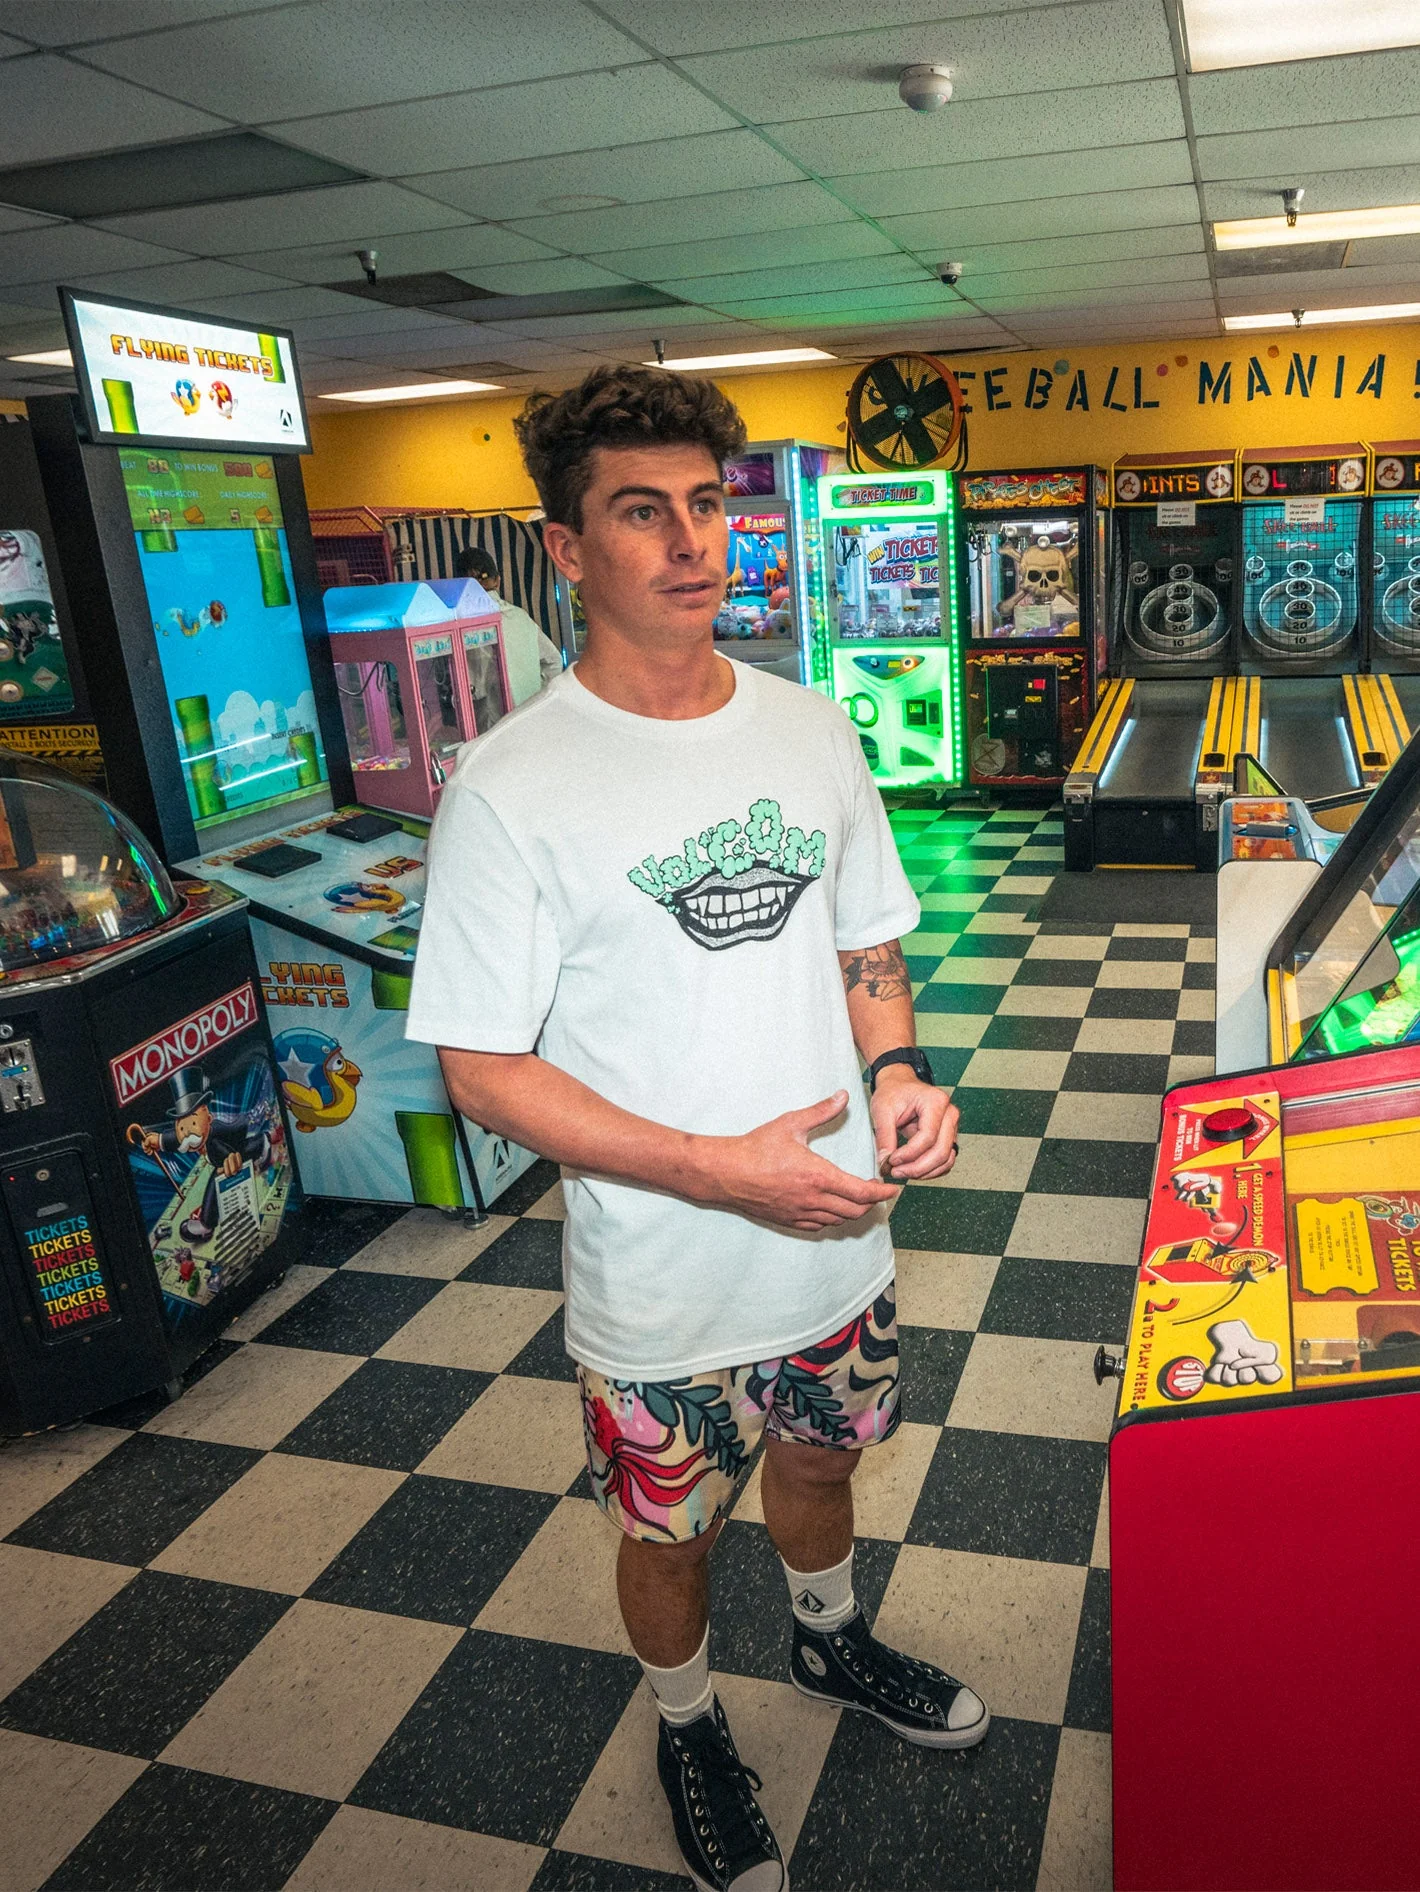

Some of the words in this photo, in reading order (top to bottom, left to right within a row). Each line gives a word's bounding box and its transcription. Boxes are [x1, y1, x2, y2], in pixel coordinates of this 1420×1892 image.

[110, 333, 190, 365] FLYING
[193, 346, 274, 377] TICKETS
[868, 365, 1160, 413] EEBALL
[1198, 352, 1386, 404] MANIA
[851, 487, 887, 504] TICKET
[889, 486, 918, 502] TIME
[1143, 474, 1199, 494] INTS
[867, 544, 885, 565] WIN
[883, 536, 938, 563] TICKET
[869, 563, 915, 583] TICKETS
[1172, 605, 1187, 613] 30
[1292, 602, 1307, 610] 30
[1172, 624, 1186, 632] 20
[1292, 621, 1308, 630] 20
[1172, 639, 1185, 647] 10
[1294, 636, 1306, 644] 10
[0, 727, 95, 741] ATTENTION
[119, 990, 250, 1097] MONOPOLY
[1237, 1180, 1248, 1199] HERE
[1252, 1173, 1263, 1187] GET
[1252, 1194, 1263, 1215] SPEED
[24, 1215, 88, 1244] TICKETS
[1252, 1215, 1264, 1247] DEMON
[28, 1229, 92, 1258] TICKETS
[32, 1243, 96, 1272] TICKETS
[1387, 1238, 1417, 1291] TICKETS
[36, 1257, 99, 1286] TICKETS
[40, 1271, 103, 1300] TICKETS
[44, 1285, 107, 1314] TICKETS
[48, 1299, 110, 1328] TICKETS
[1142, 1325, 1155, 1339] TO
[1137, 1343, 1153, 1368] PLAY
[1132, 1373, 1149, 1401] HERE
